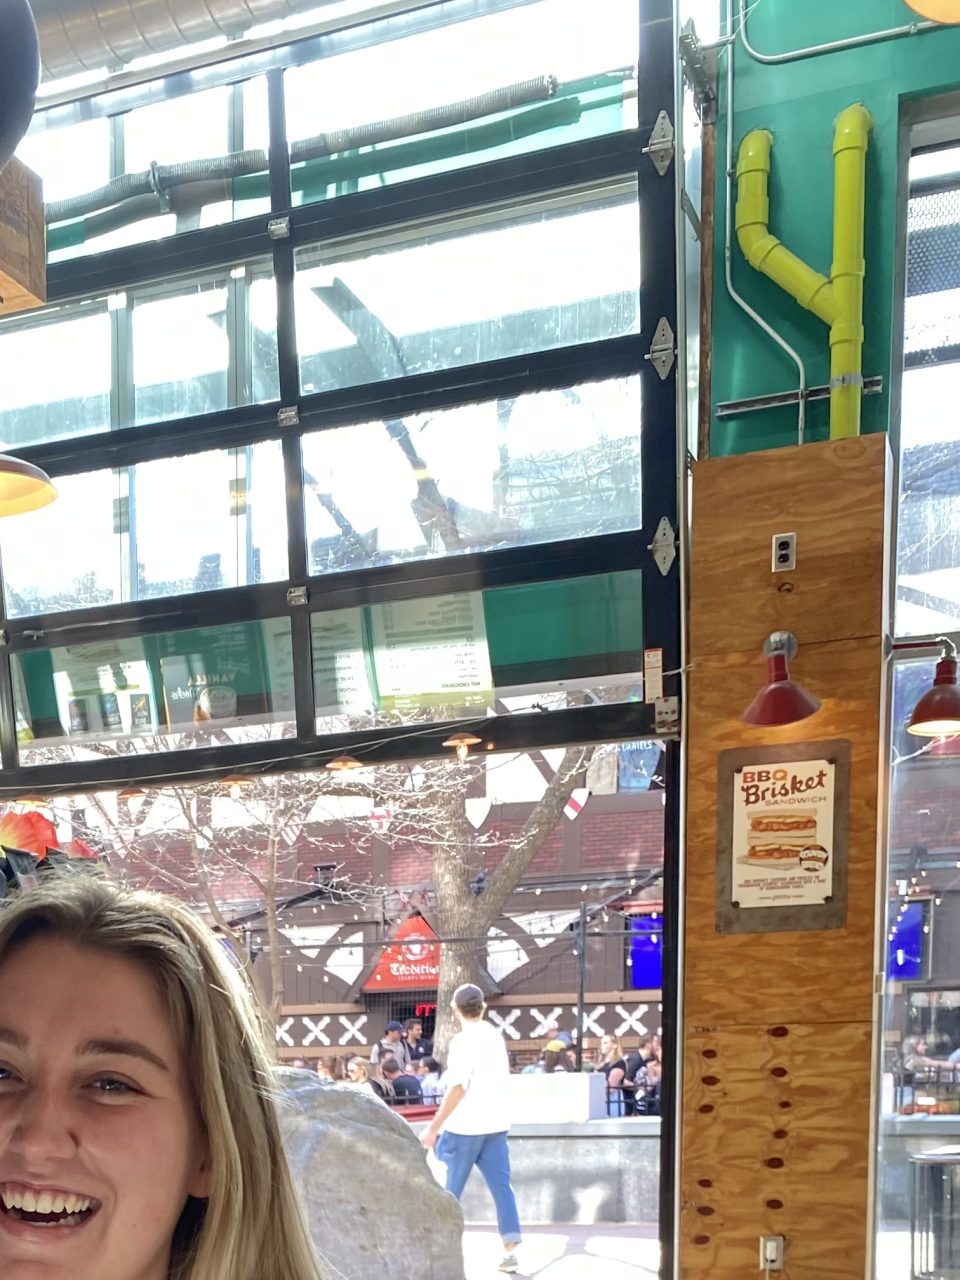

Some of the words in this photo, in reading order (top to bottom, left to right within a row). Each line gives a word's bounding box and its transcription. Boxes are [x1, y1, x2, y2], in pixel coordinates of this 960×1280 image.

[743, 769, 788, 784] BBQ
[741, 769, 828, 806] Brisket
[764, 796, 827, 807] SANDWICH
